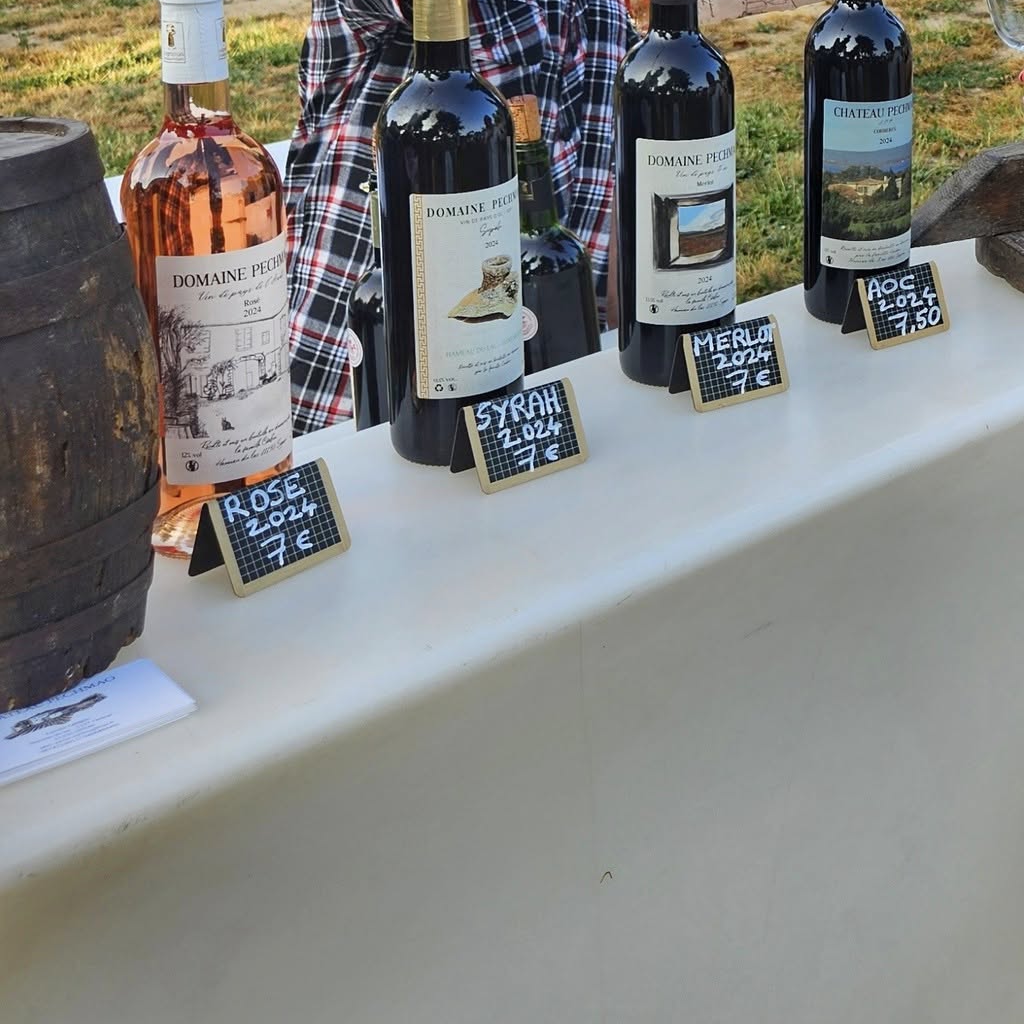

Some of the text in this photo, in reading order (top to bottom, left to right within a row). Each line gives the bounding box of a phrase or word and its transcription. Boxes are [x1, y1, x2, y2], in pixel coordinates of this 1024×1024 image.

[833, 106, 885, 119] CHATEAU
[647, 154, 702, 167] DOMAINE
[426, 202, 485, 218] DOMAINE
[484, 240, 499, 248] 2024
[172, 267, 248, 288] DOMAINE
[697, 276, 713, 284] 2024
[867, 274, 915, 301] AOC
[243, 306, 262, 317] 2024
[877, 286, 937, 312] 2024
[887, 306, 942, 336] 7,50
[693, 323, 776, 356] MERLOT
[712, 346, 772, 370] 2024
[476, 385, 561, 431] SYRAH
[497, 416, 562, 449] 2024
[224, 472, 305, 522] ROSE
[246, 497, 317, 537] 2024
